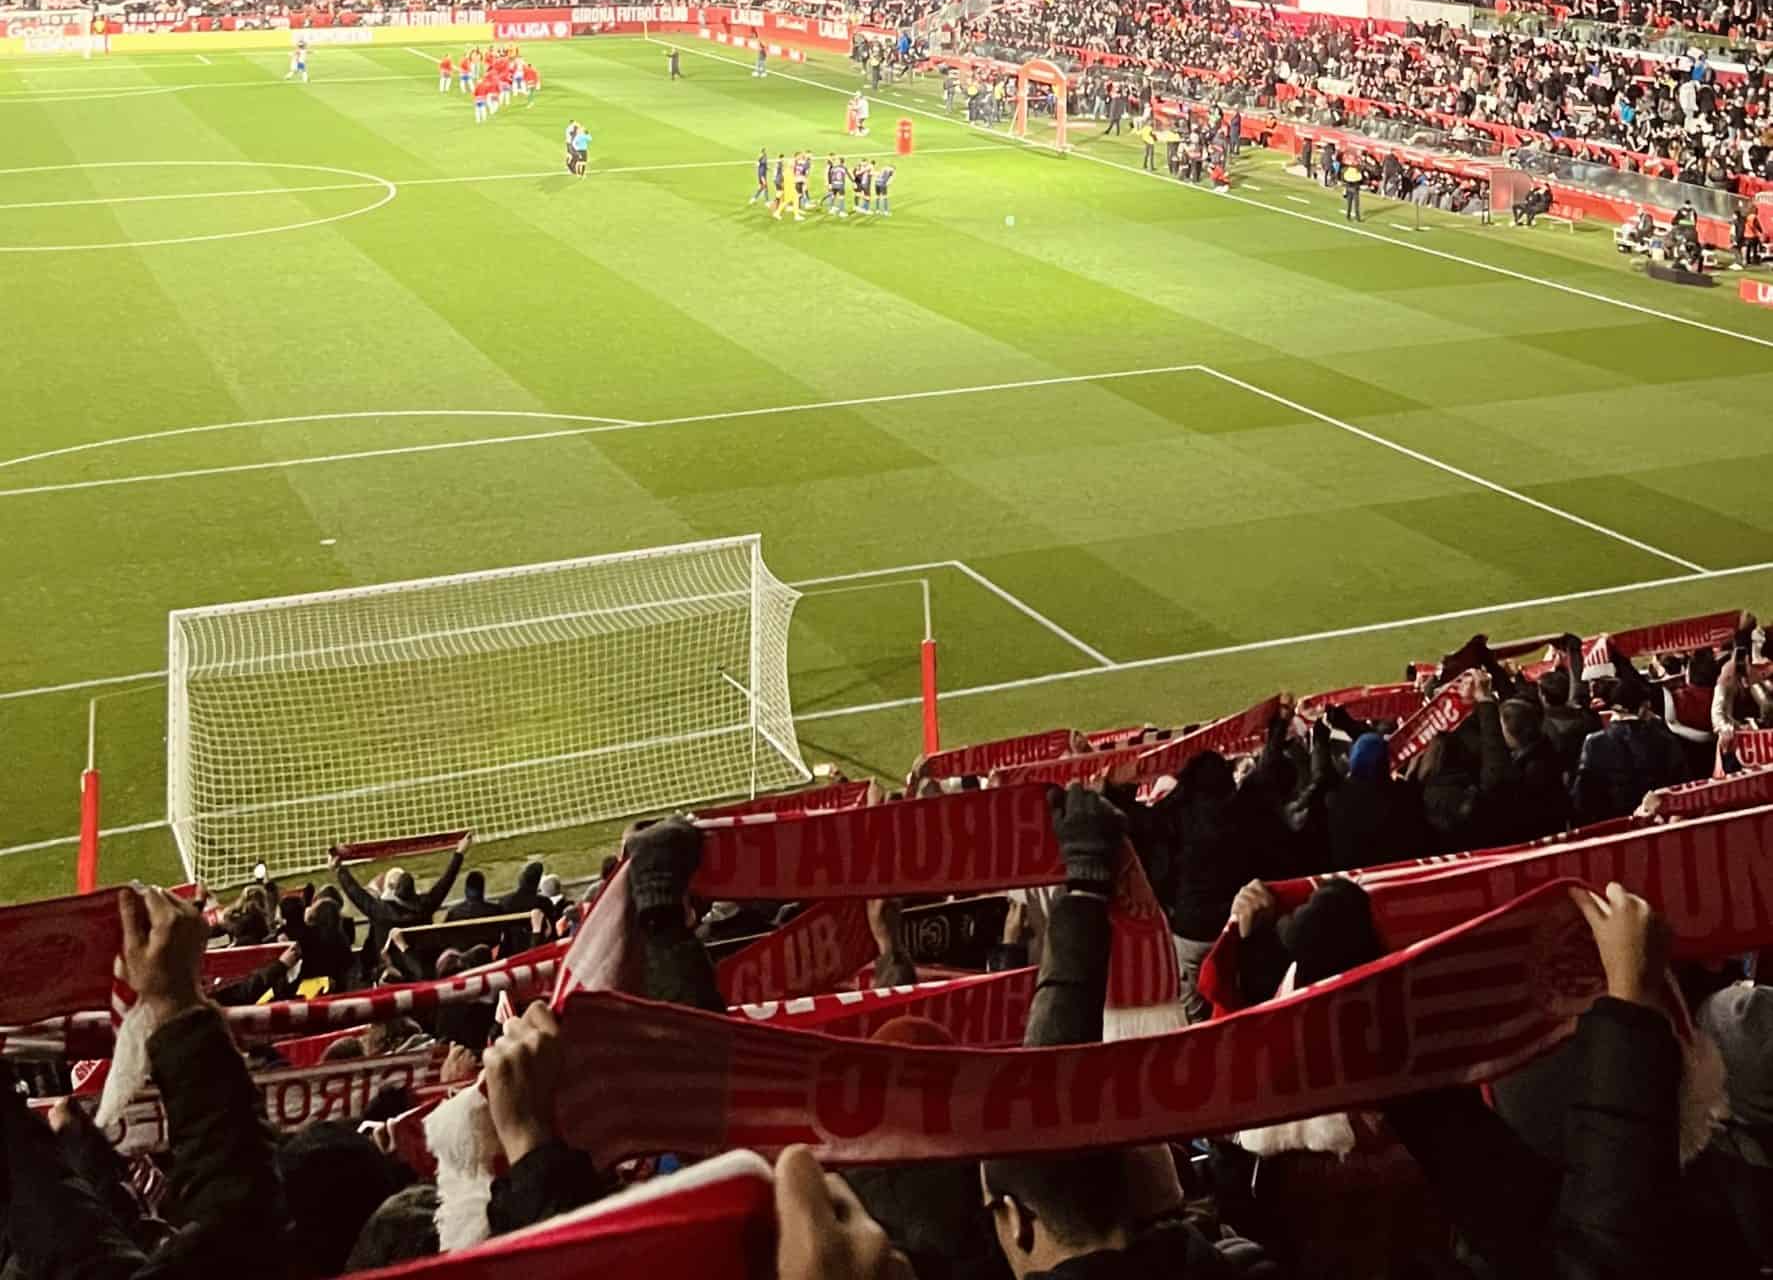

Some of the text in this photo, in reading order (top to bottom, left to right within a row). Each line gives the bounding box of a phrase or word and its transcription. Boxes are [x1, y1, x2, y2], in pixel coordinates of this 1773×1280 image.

[572, 7, 614, 23] GIRONA
[617, 6, 658, 22] FUTBOL
[498, 23, 550, 38] LALIGA
